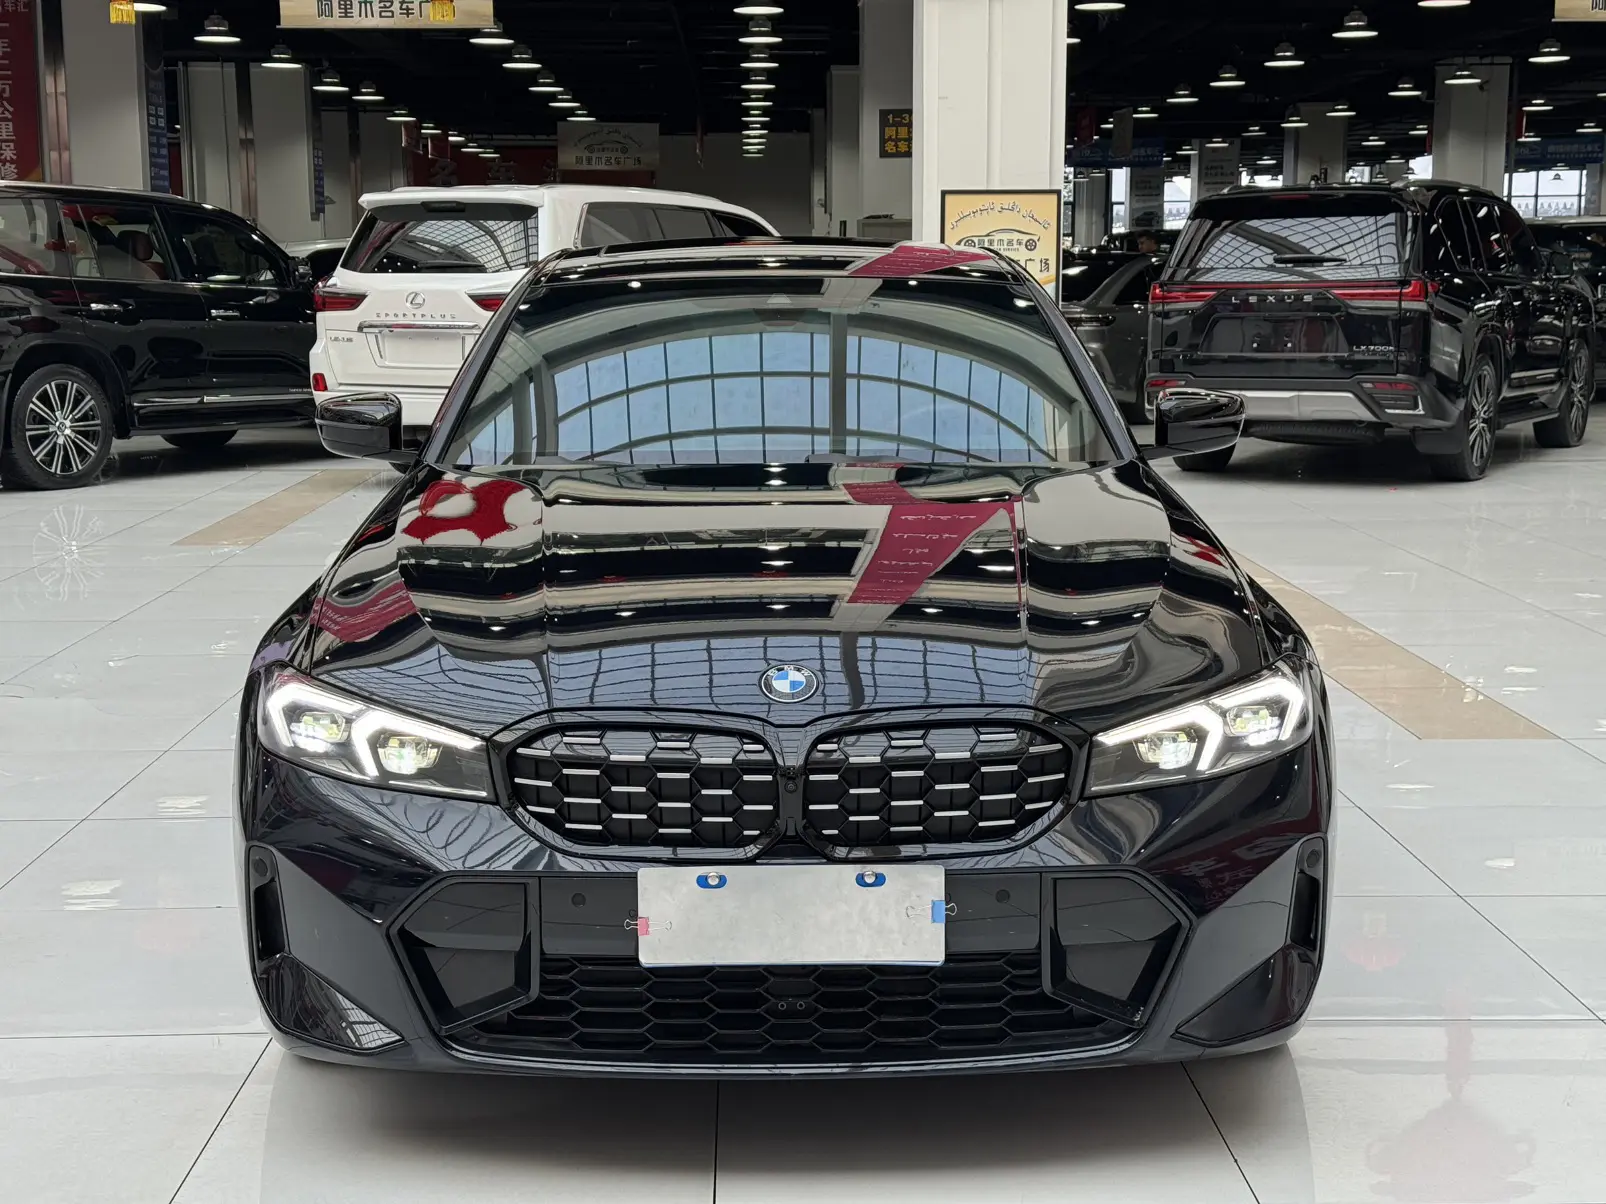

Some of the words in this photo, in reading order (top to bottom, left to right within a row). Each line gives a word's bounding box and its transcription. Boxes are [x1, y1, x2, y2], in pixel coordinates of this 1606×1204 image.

[317, 0, 456, 18] 阿里木名车广
[887, 113, 912, 124] 1-3
[884, 126, 912, 139] 阿里
[884, 141, 912, 153] 名车
[1231, 294, 1313, 303] LEXUS
